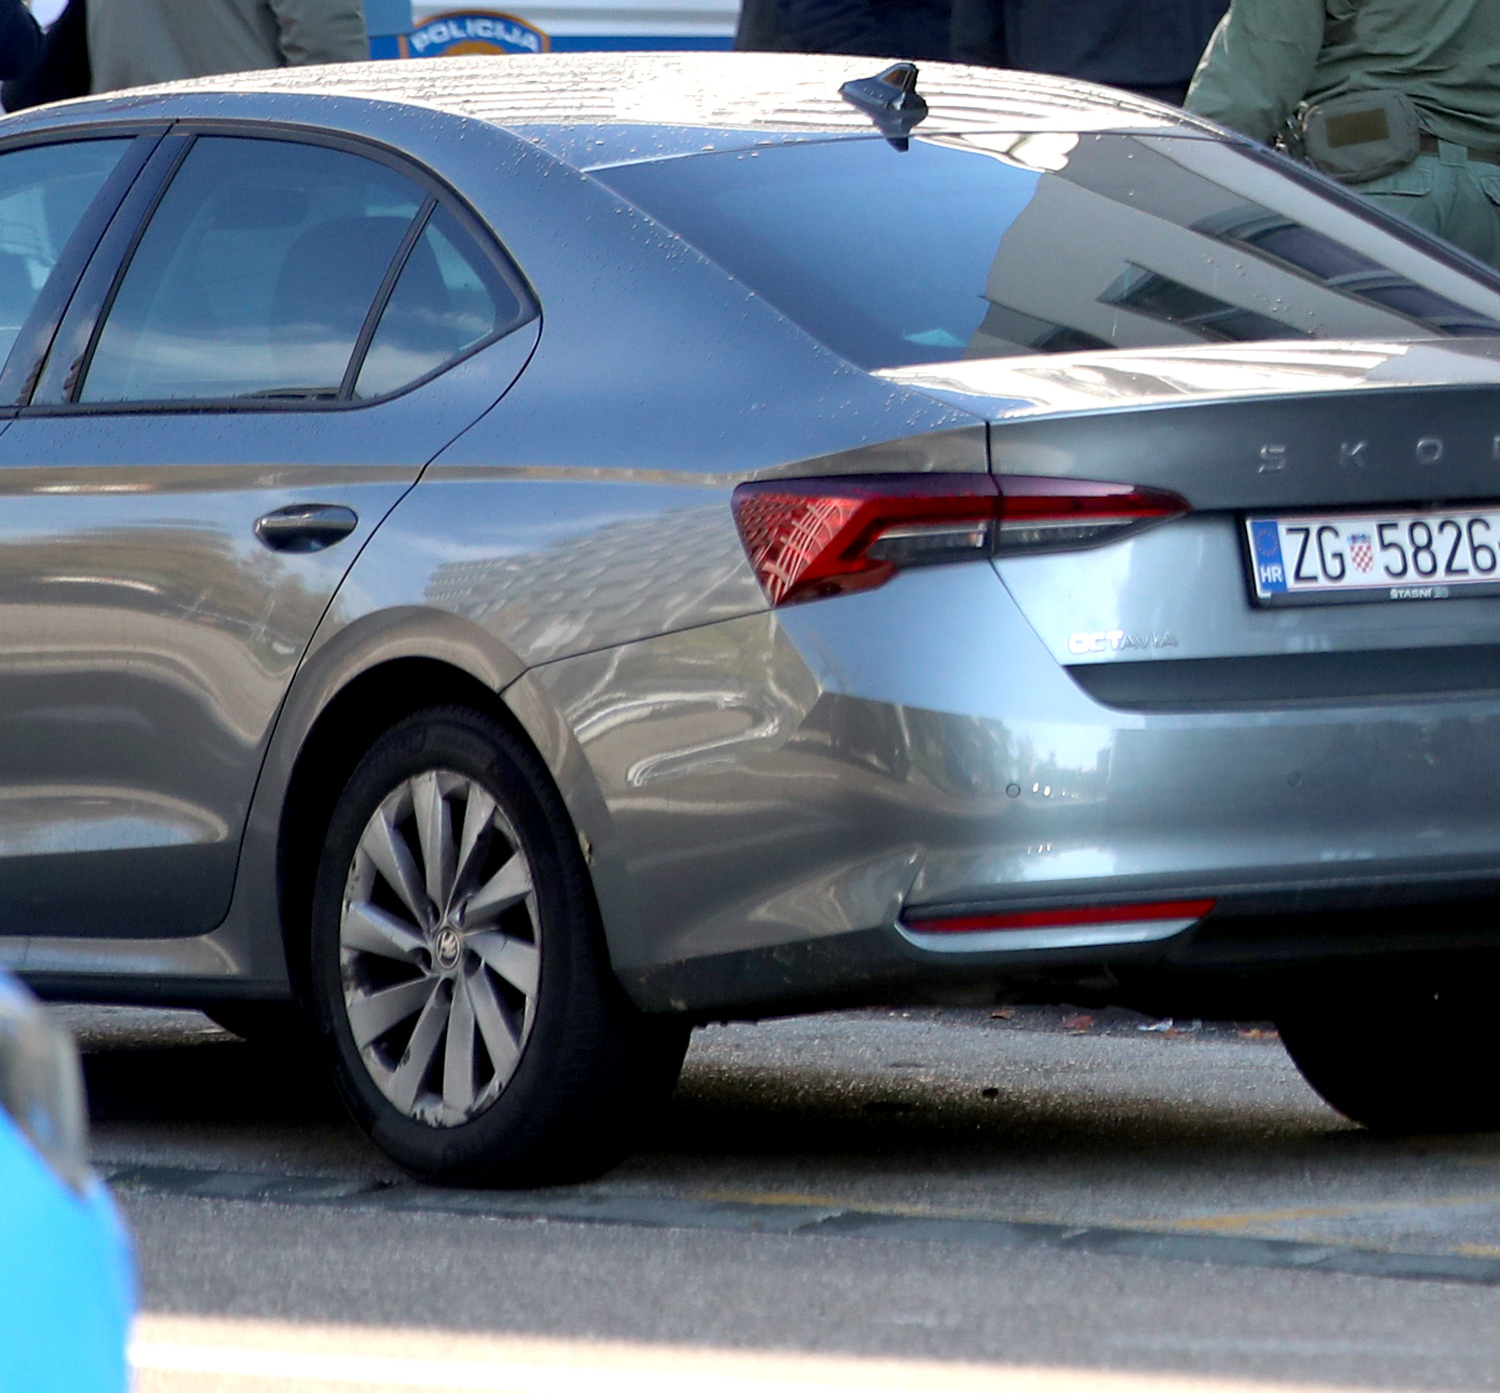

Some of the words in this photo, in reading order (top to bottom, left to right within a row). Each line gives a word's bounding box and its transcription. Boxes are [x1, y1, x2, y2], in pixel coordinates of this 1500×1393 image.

[409, 18, 540, 53] POLICIJA
[1285, 525, 1346, 584] ZG
[1259, 565, 1284, 584] HR
[1067, 629, 1179, 655] OCTAVIA
